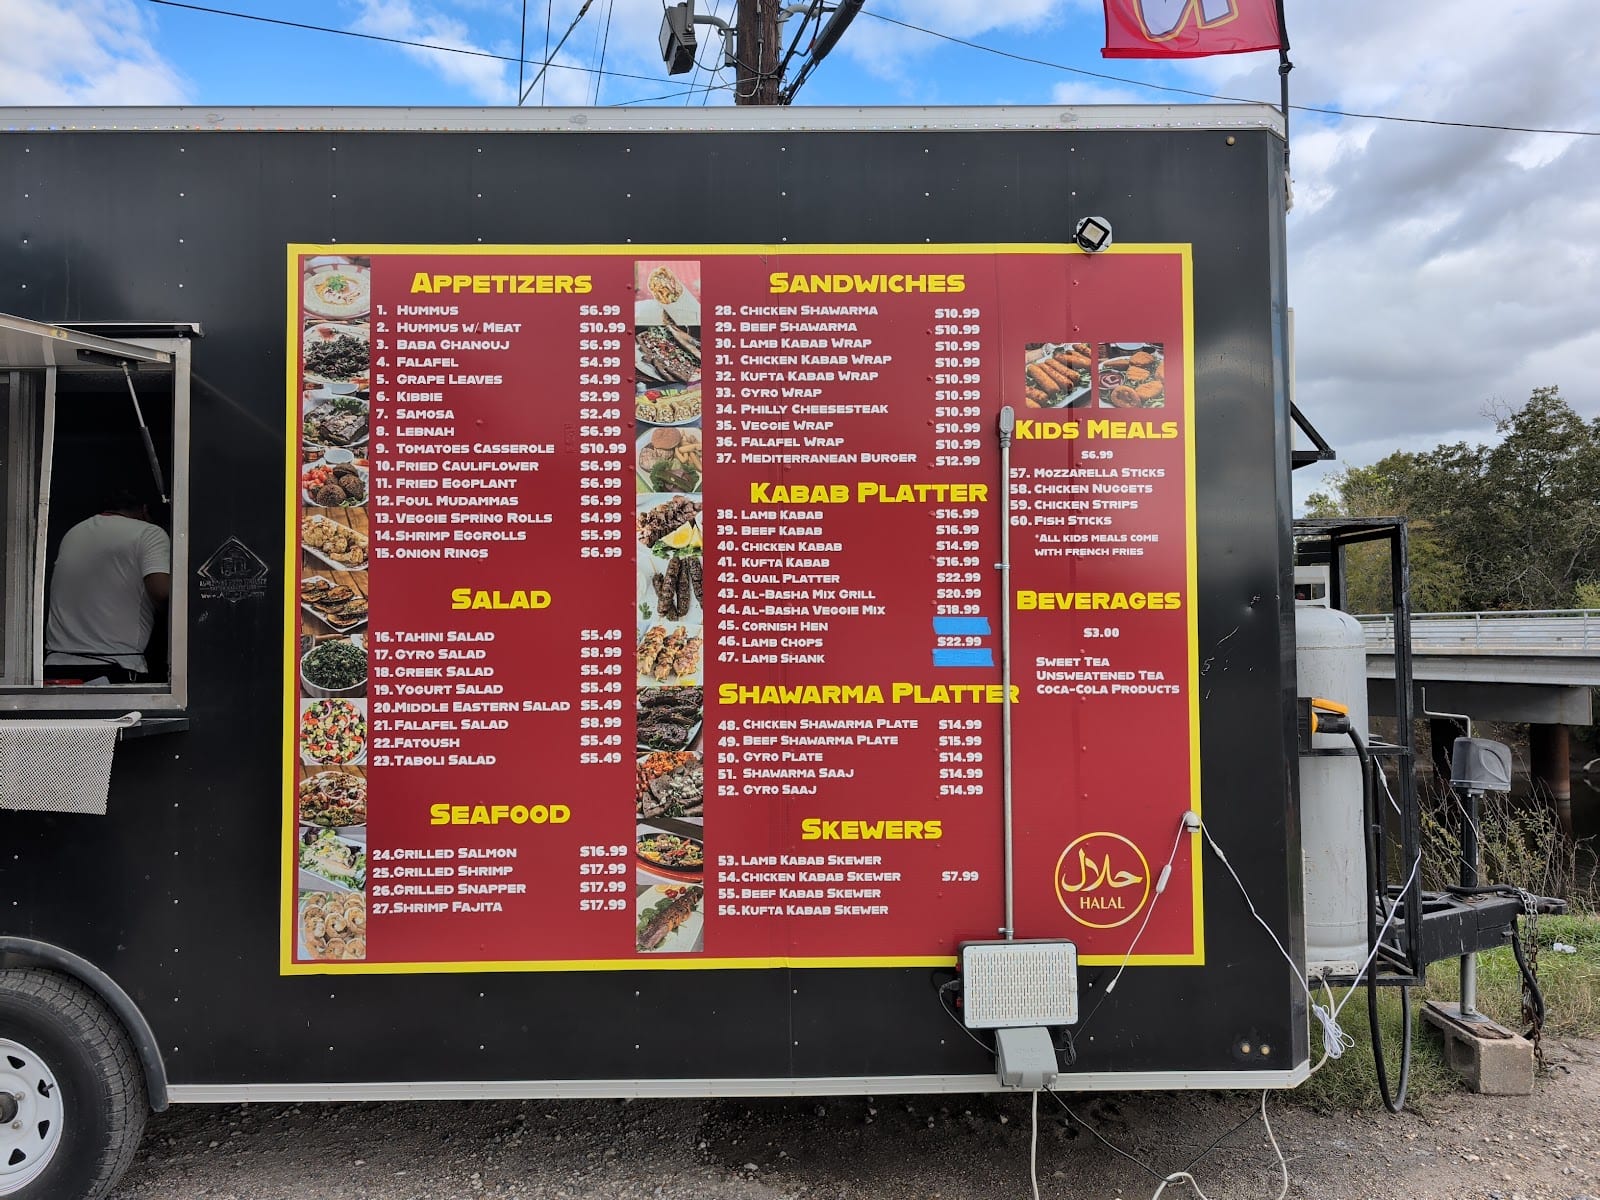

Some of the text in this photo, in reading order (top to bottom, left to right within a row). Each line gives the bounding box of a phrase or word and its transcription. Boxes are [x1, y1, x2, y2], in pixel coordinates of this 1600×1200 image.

[411, 273, 592, 293] APPETIZERS
[770, 273, 965, 293] SANDWICHES
[377, 305, 620, 315] 1. HUMMUS $6.99
[715, 305, 980, 318] 28. CHICKEN SHAWARMA $10.99
[377, 322, 389, 332] 2.
[397, 323, 458, 332] HUMMUS
[483, 322, 521, 332] MEAT
[580, 322, 625, 333] $10.99
[377, 340, 620, 350] 3. BABA GHANOUJ $6.99
[716, 338, 980, 351] 30. LAMB KABAB WRAP $10.99
[377, 357, 620, 367] 4. FALAFEL $4.99
[377, 374, 620, 384] 5. GRAPE LEAVES $4.99
[377, 391, 619, 402] 6. KIBBIE $2.99
[716, 388, 980, 400] 33. GYRO WRAP $10.99
[376, 409, 620, 419] 7. SAMOSA $2.49
[376, 426, 621, 436] 8. LEBNAH $6.99
[1016, 420, 1178, 440] KIDS MEALS
[376, 443, 626, 453] 9. TOMATOES CASSEROLE $10.99
[716, 437, 980, 449] 36. FALAFEL WRAP $10.99
[717, 453, 980, 466] 37. MEDITERRANEAN BURGER $12.99
[1081, 450, 1113, 459] $6.99
[1010, 468, 1165, 478] 57. MOZZARELLA STICKS
[376, 478, 621, 488] 11. FRIED EGGPLANT $6.99
[1092, 484, 1153, 493] NUGGETS
[751, 483, 987, 503] KABAB PLATTER
[1092, 500, 1138, 509] STRIPS
[1068, 516, 1112, 525] STICKS
[717, 525, 979, 535] 39. BEEF KABAB $16.99
[1130, 534, 1159, 542] COME
[718, 573, 980, 583] 42. QUAIL PLATTER $22.99
[452, 589, 551, 609] SALAD
[1017, 591, 1181, 609] BEVERAGES
[801, 622, 828, 631] HEN
[1084, 628, 1119, 637] $3.00
[781, 638, 823, 647] CHOPS
[938, 637, 981, 646] $22.99
[439, 649, 486, 659] SALAD
[581, 647, 621, 658] $8.99
[1036, 657, 1110, 666] SWEET TEA
[447, 667, 493, 676] SALAD
[581, 665, 621, 675] $5.49
[1037, 671, 1164, 680] UNSWEATENED TEA
[456, 684, 503, 694] SALAD
[581, 682, 621, 693] $5.49
[719, 683, 1019, 704] SHAWARMA PLATTER
[1037, 684, 1179, 694] COCA-COLA PRODUCTS
[461, 719, 508, 729] SALAD
[581, 717, 621, 728] $8.99
[718, 752, 982, 763] 50. GYRO PLATE $14.99
[431, 804, 570, 824] SEAFOOD
[802, 819, 942, 839] SKEWERS
[719, 855, 881, 866] 53. LAMB KABAB SKEWER
[458, 866, 513, 876] SHRIMP
[580, 864, 626, 874] $17.99
[1061, 848, 1143, 892] حلال
[799, 872, 843, 881] KABAB
[847, 872, 901, 881] SKEWER
[942, 871, 978, 881] $7.99
[453, 902, 502, 912] FAJITA
[580, 899, 626, 910] $17.99
[1080, 896, 1125, 909] HALAL
